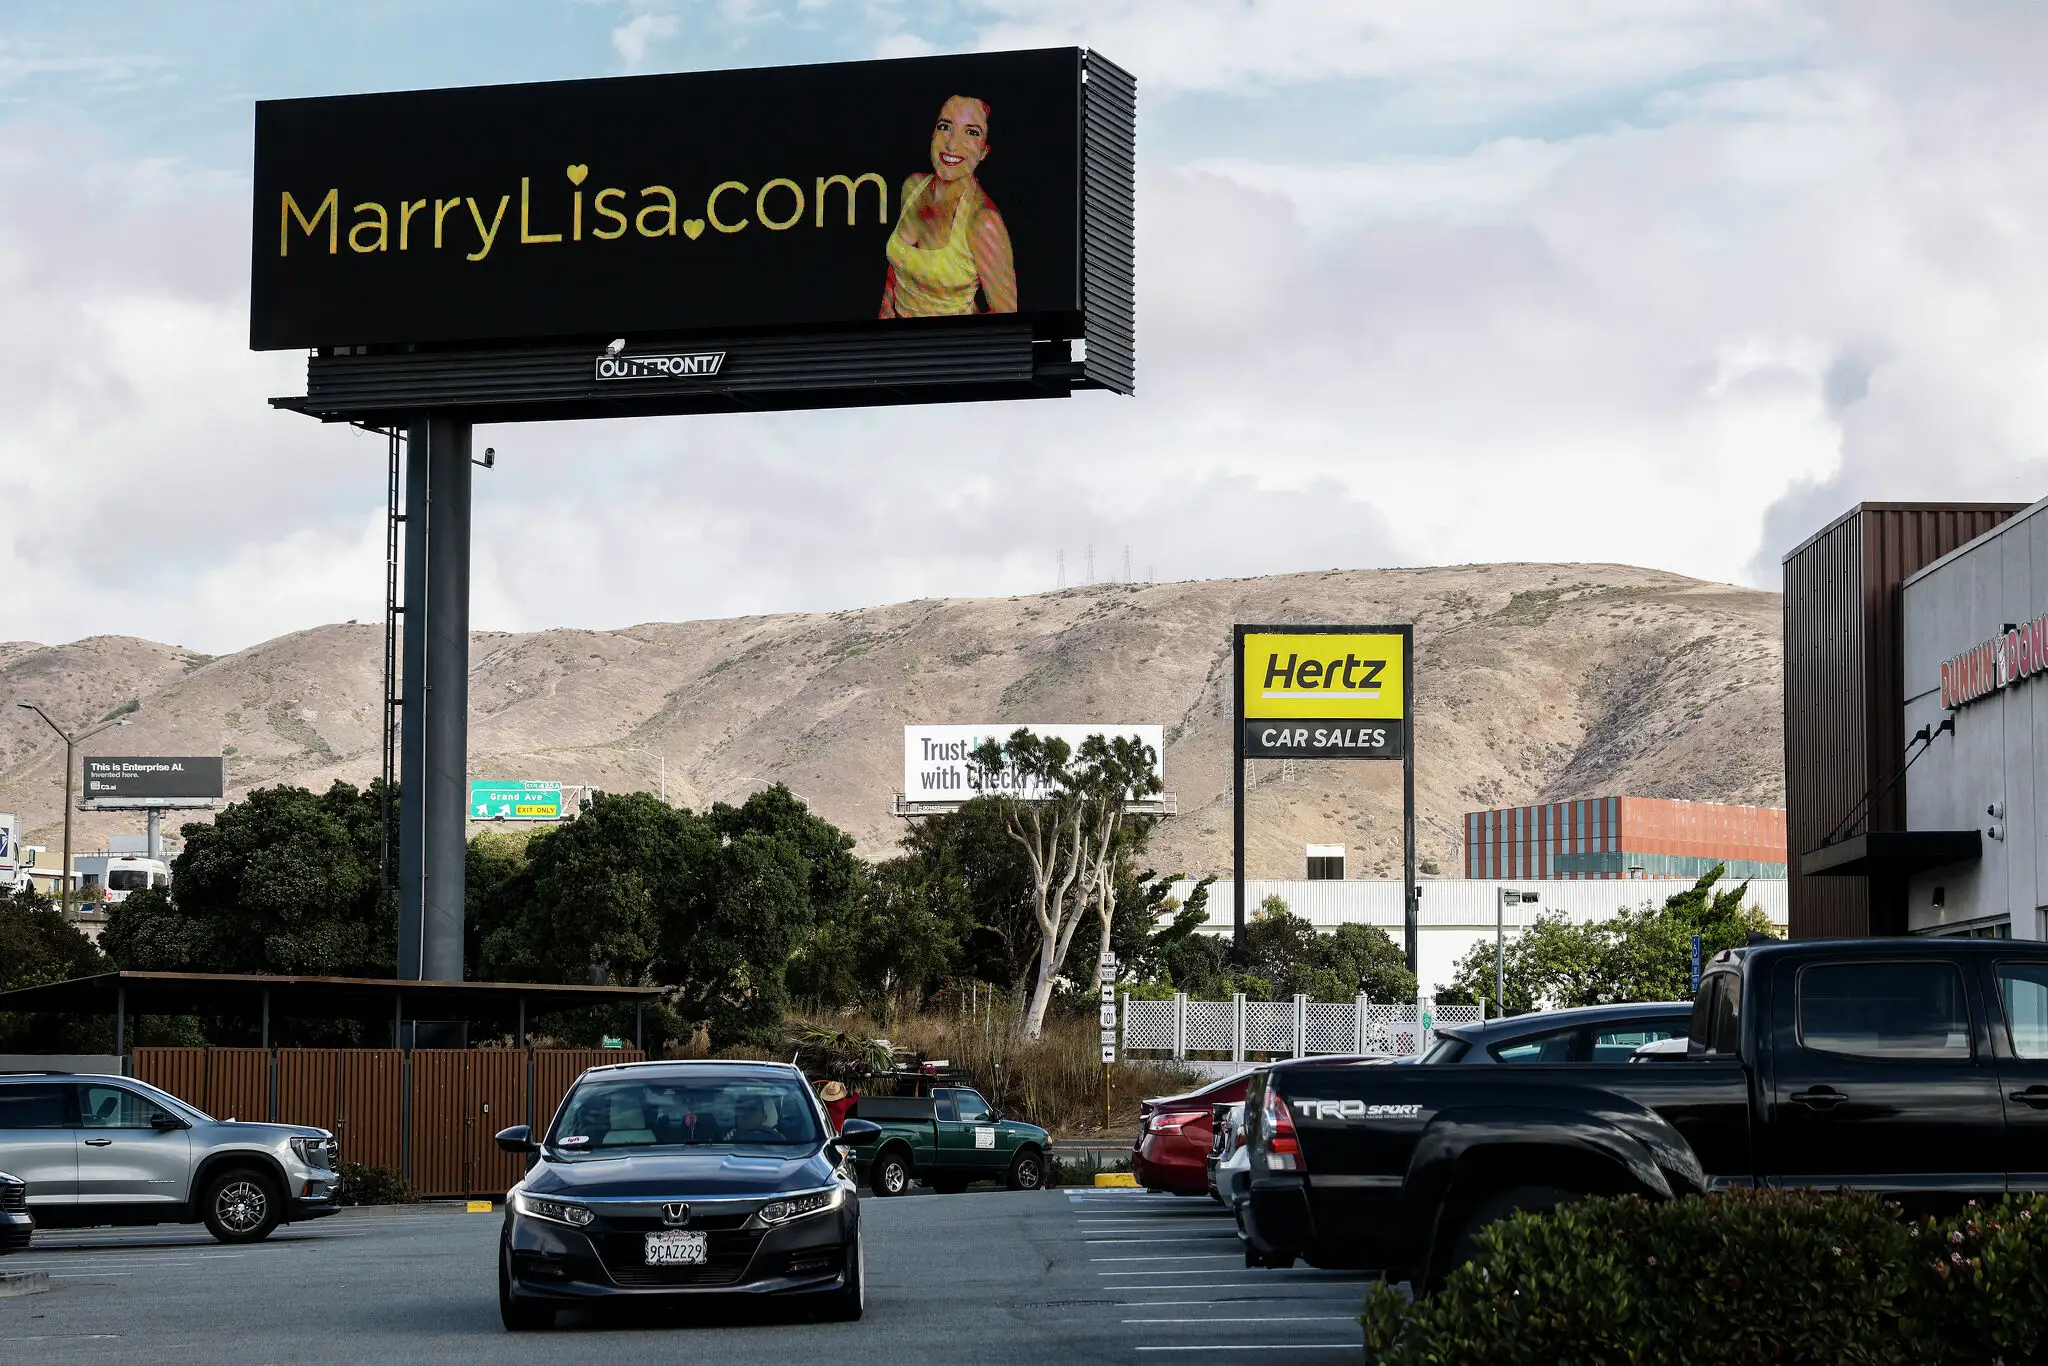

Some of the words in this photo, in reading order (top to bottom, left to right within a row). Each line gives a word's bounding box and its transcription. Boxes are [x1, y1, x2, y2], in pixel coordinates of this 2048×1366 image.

[281, 164, 890, 262] MarryLisa.com
[1263, 653, 1387, 689] Hertz
[1261, 729, 1309, 748] CAR
[1312, 729, 1386, 748] SALES
[921, 738, 967, 761] Trust
[90, 763, 110, 771] This
[112, 763, 120, 771] is
[122, 763, 170, 772] Enterprise
[171, 763, 184, 771] AI.
[921, 766, 961, 790] with
[1104, 954, 1112, 962] TO
[1104, 1013, 1114, 1024] 101
[1294, 1100, 1366, 1120] TRD
[1367, 1105, 1423, 1115] SPORT
[650, 1244, 702, 1260] 9CAZ229
